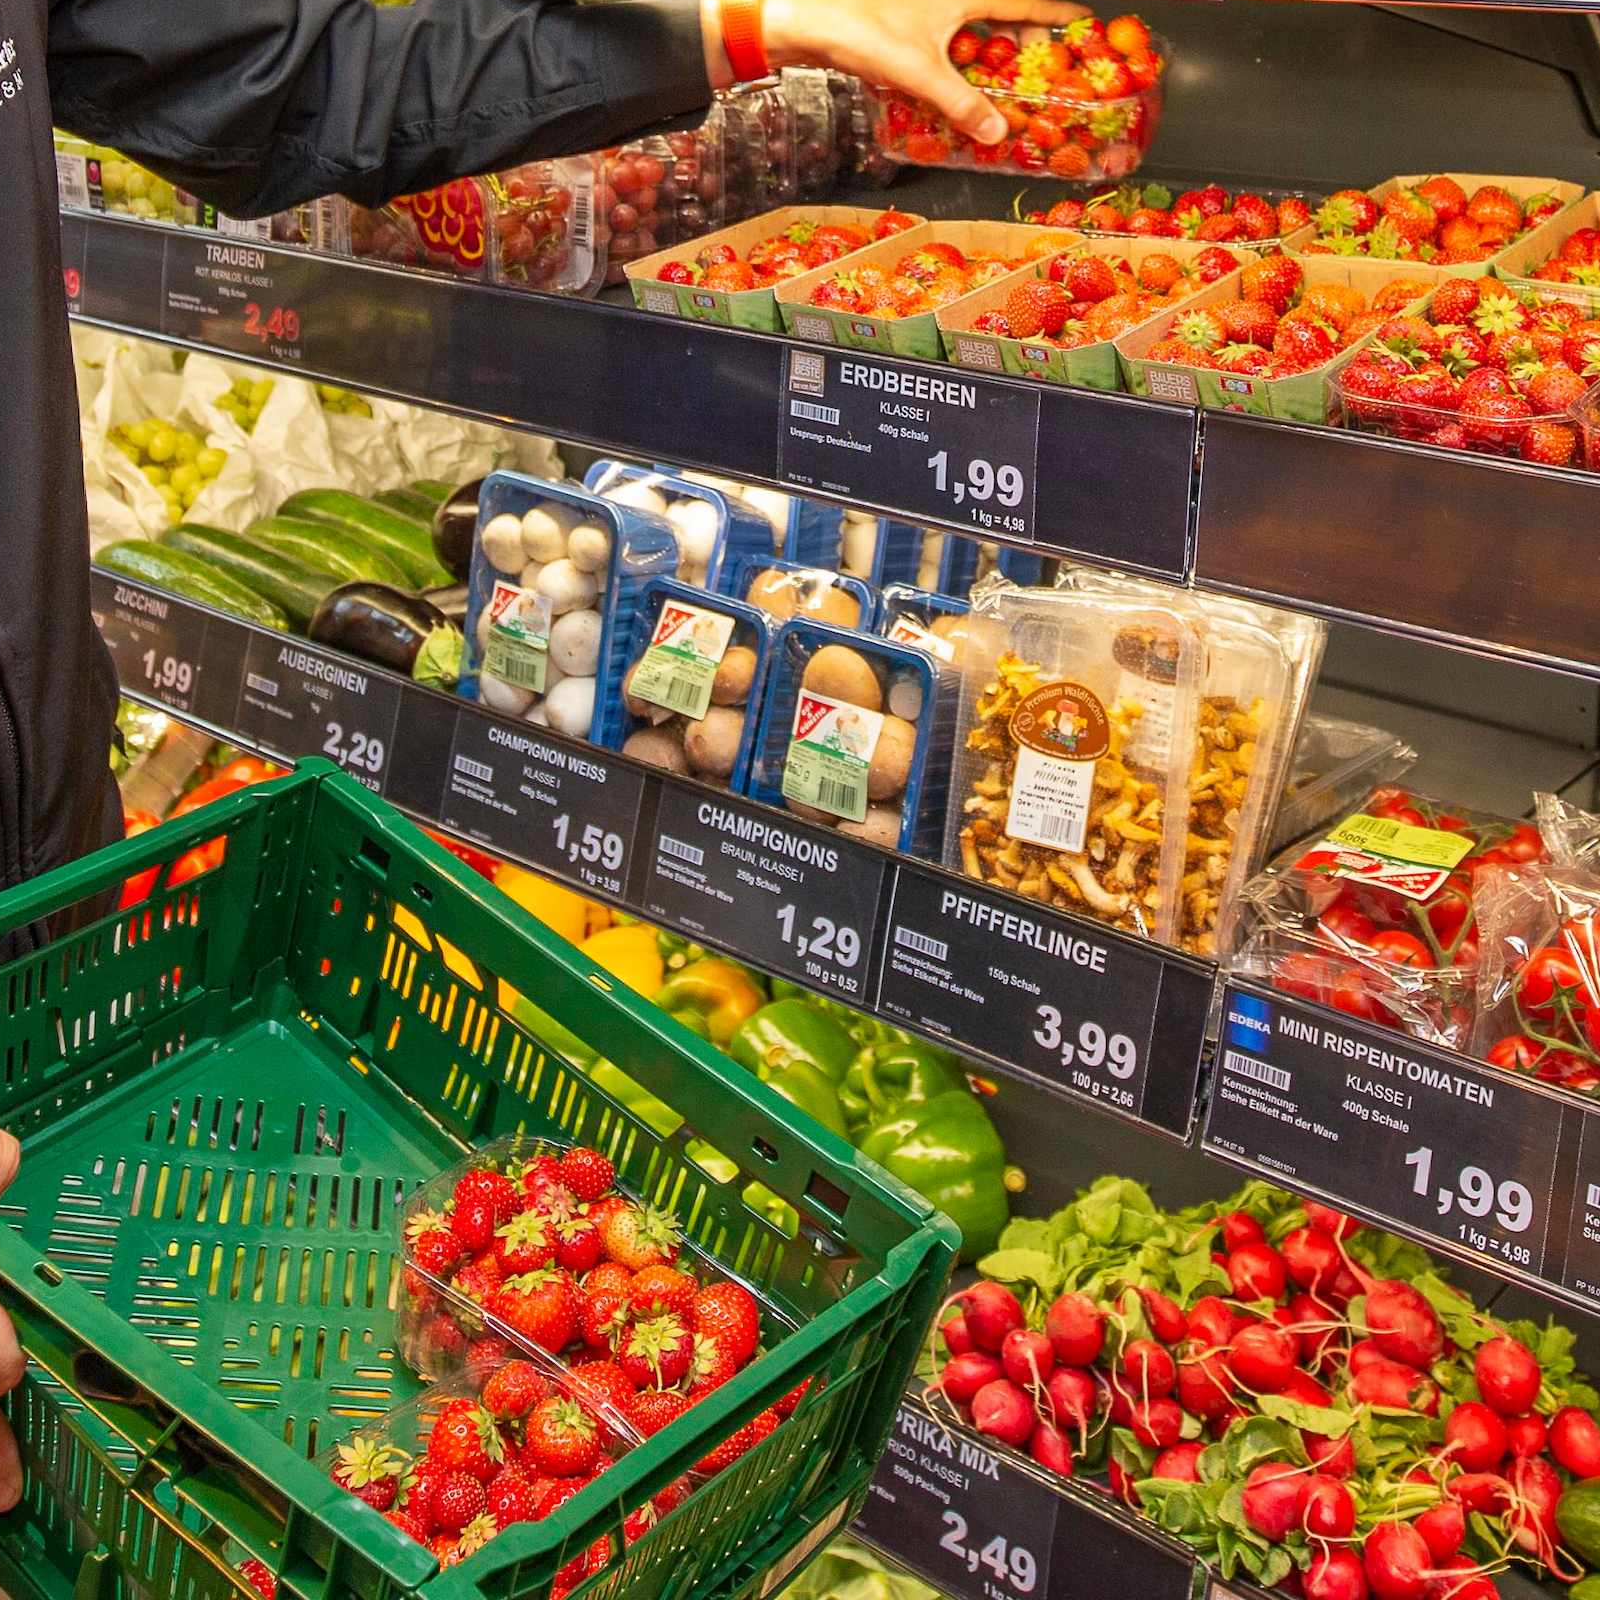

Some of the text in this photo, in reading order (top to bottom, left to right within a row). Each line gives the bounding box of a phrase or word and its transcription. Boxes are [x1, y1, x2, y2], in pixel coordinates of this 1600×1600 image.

[205, 243, 265, 270] TRAUBEN
[244, 302, 300, 342] 2,49
[961, 351, 996, 366] BESTE
[839, 363, 977, 410] ERDBEEREN
[1152, 384, 1193, 400] BESTE
[879, 401, 925, 422] KLASSE
[826, 434, 872, 453] Deutschland
[927, 450, 1024, 507] 1,99
[1003, 516, 1025, 533] 4,98
[114, 585, 169, 620] ZUCCHINI
[141, 650, 192, 693] 1,99
[277, 646, 368, 696] AUBERGINEN
[1024, 686, 1104, 725] Premium Waldfrüchte
[322, 721, 385, 773] 2,29
[487, 726, 607, 784] CHAMPIGNON WEISS
[522, 765, 556, 789] KLASSE
[552, 813, 624, 872] 1,59
[697, 803, 839, 874] CHAMPIGNONS
[720, 840, 798, 881] BRAUN, KLASSE
[775, 903, 861, 969] 1,29
[941, 890, 1107, 975] PFIFFERLINGE
[988, 966, 1041, 996] 150g Schale
[1033, 1004, 1137, 1080] 3,99
[1228, 1010, 1271, 1035] EDEKA
[1278, 1015, 1495, 1108] MINI RISPENTOMATEN
[1110, 1088, 1134, 1108] 2,66
[1222, 1075, 1299, 1113] Kennzeichnung:
[1345, 1074, 1405, 1107] KLASSE
[1342, 1099, 1410, 1134] 400g Schale
[1404, 1145, 1534, 1233] 1,99
[1501, 1242, 1531, 1265] 4,98
[959, 1448, 1000, 1481] MIX
[939, 1511, 1037, 1592] 2,49
